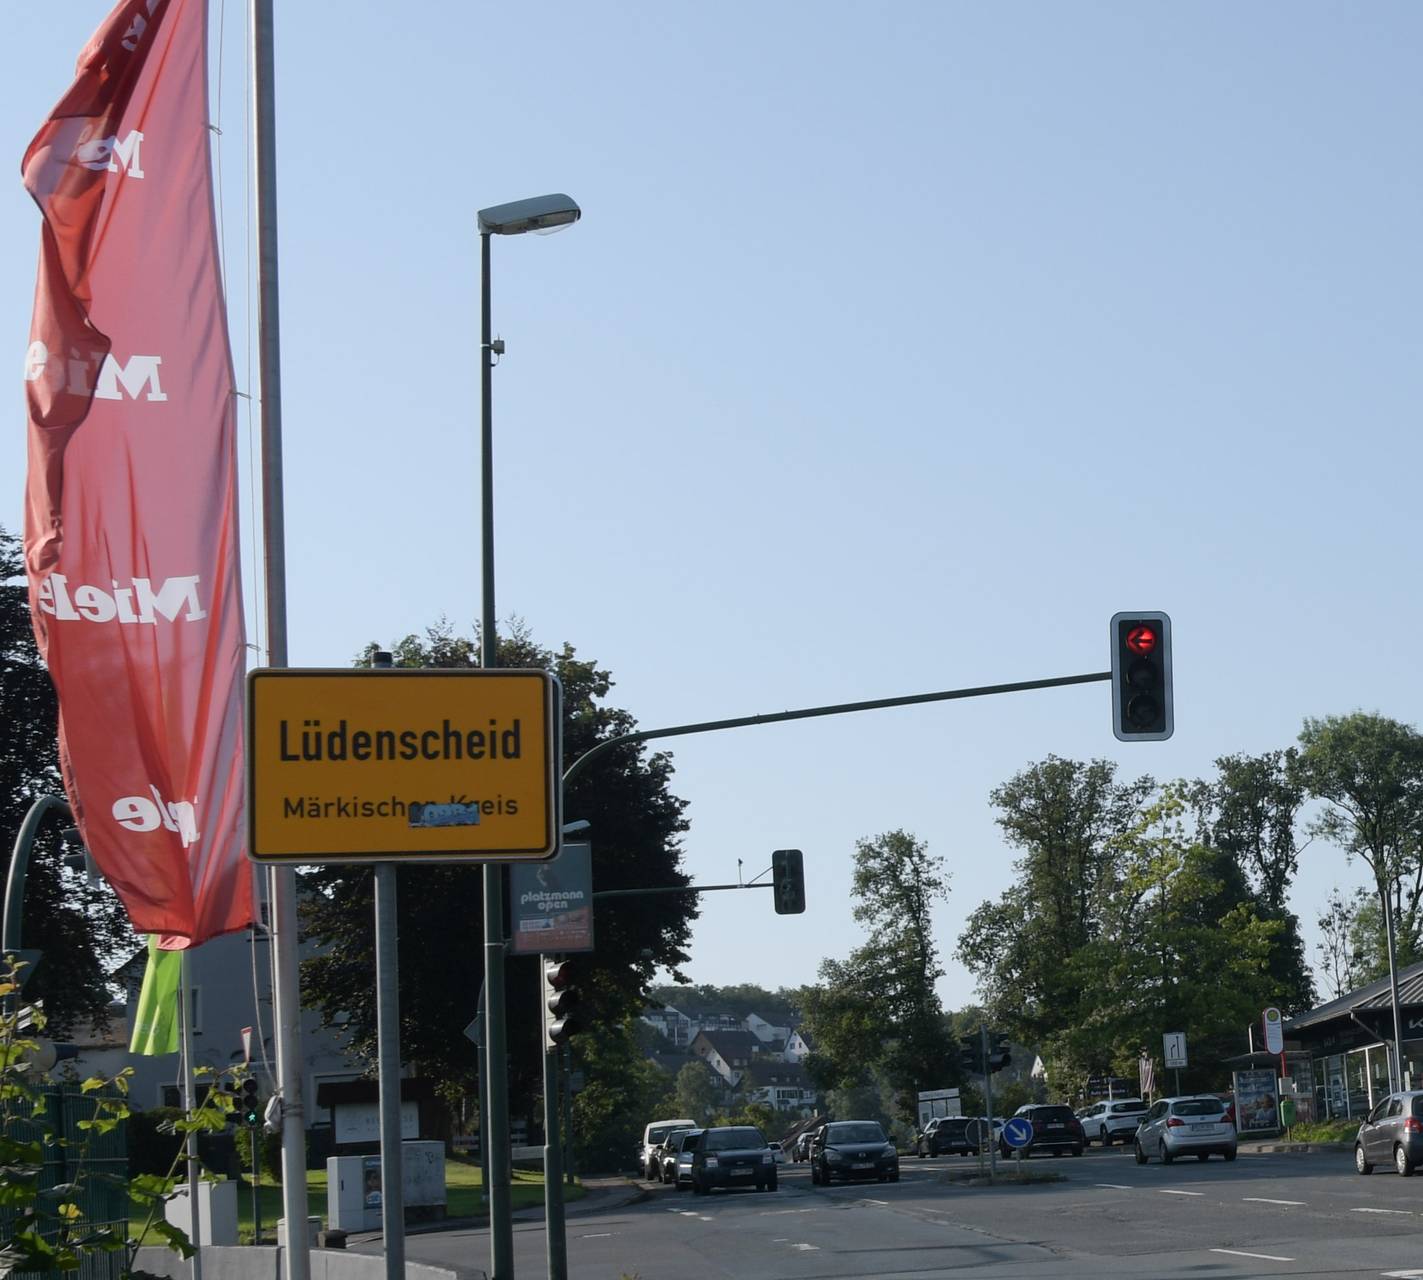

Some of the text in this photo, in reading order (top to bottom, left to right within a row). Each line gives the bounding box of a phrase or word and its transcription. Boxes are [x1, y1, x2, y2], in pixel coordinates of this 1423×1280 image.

[280, 719, 521, 761] Lüdenscheid
[521, 890, 584, 905] platzmann
[538, 901, 568, 912] open
